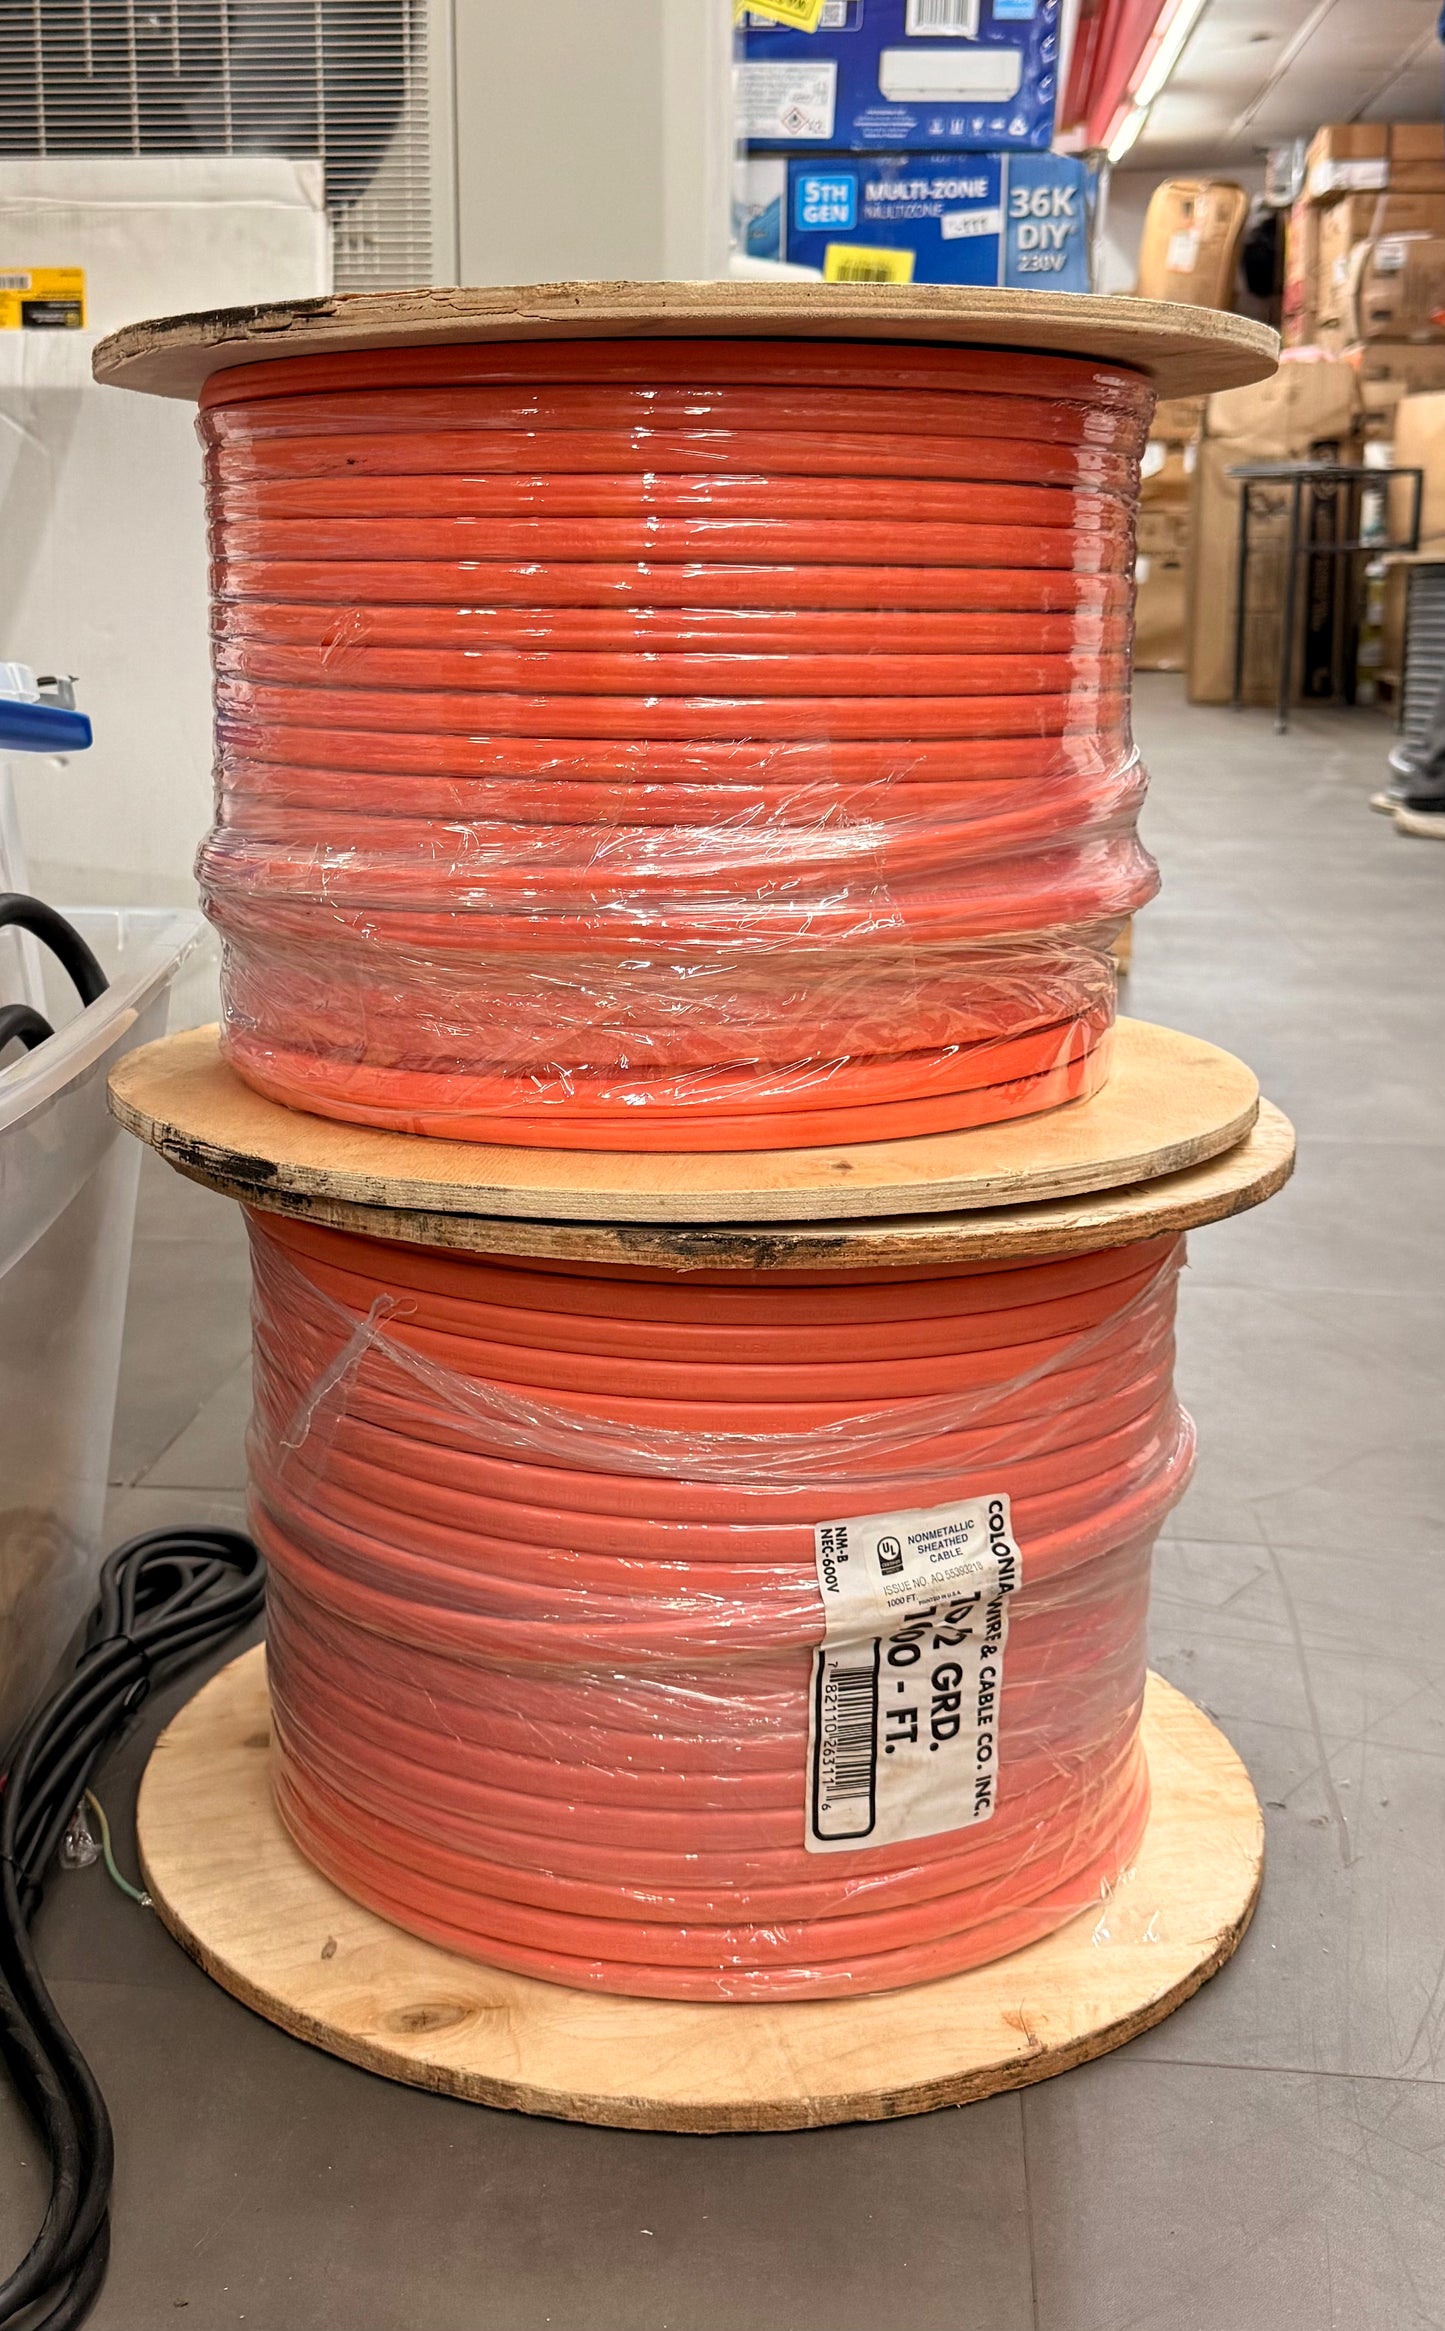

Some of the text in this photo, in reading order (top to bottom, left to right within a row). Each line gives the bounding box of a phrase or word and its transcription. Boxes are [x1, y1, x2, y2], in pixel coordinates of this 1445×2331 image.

[804, 181, 848, 203] 5TH
[865, 178, 988, 201] MULTI-ZONE
[1009, 186, 1077, 218] 36K
[803, 205, 848, 223] GEN
[1018, 223, 1068, 250] DIY
[1018, 253, 1067, 272] 230V
[835, 1527, 848, 1562] NM-B
[907, 1520, 974, 1544] NONMETALLIC
[917, 1533, 968, 1554] SHEATHED
[820, 1528, 839, 1593] NEC-600V
[930, 1547, 963, 1562] CABLE
[988, 1500, 1015, 1595] COLONIA
[883, 1580, 912, 1596] ISSUE
[913, 1576, 928, 1590] NO.
[931, 1571, 945, 1585] AQ
[887, 1593, 918, 1608] 1000 FT.
[981, 1645, 997, 1660] &
[825, 1684, 837, 1733] 82110
[930, 1662, 963, 1751] GRD.
[977, 1666, 996, 1726] CABLE
[885, 1707, 918, 1754] FT.
[822, 1739, 837, 1785] 26311
[977, 1733, 993, 1769] CO.
[821, 1803, 831, 1812] 6
[974, 1775, 992, 1816] INC.
